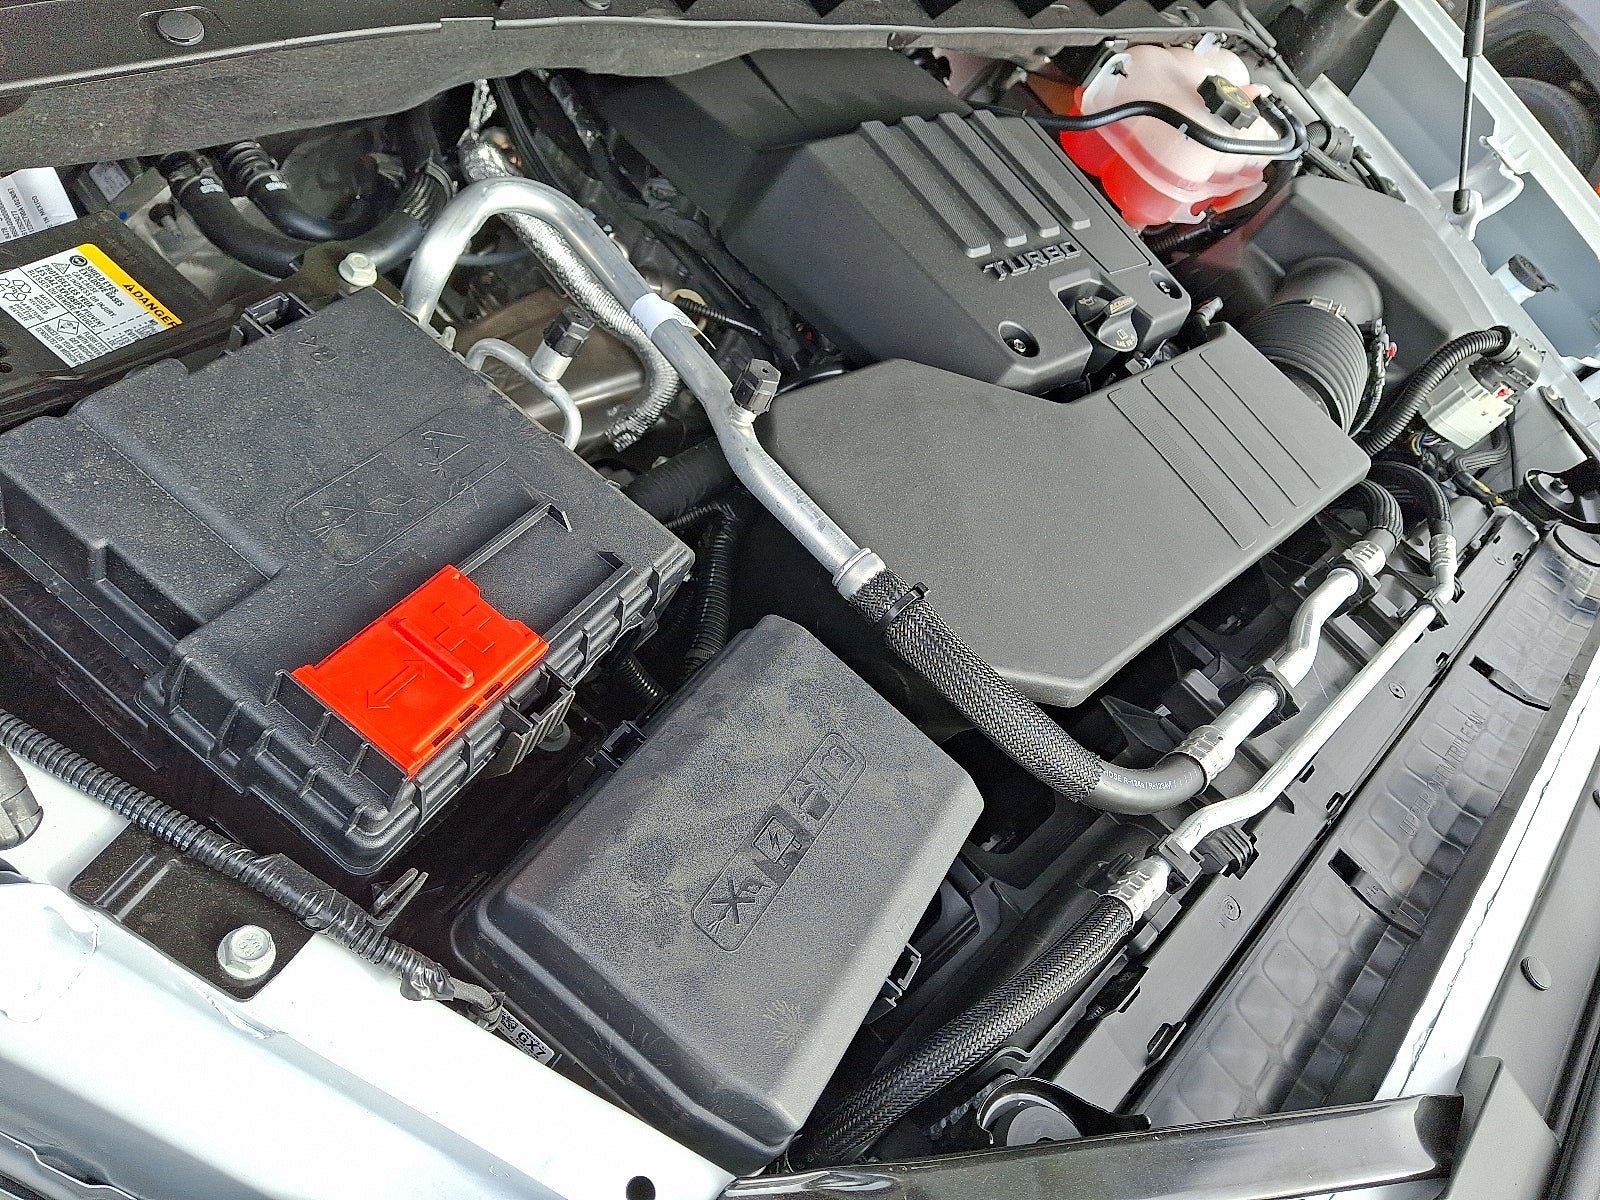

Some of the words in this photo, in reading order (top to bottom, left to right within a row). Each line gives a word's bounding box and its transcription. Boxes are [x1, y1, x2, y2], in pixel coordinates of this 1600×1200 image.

[31, 195, 47, 217] MEXICO
[87, 265, 105, 282] SHIELD
[982, 241, 1082, 281] TURBO
[27, 270, 51, 288] BLESSER
[55, 294, 77, 311] RENDRE
[42, 264, 72, 287] PROTÉGEZ
[68, 286, 80, 296] LES
[65, 273, 93, 297] BLINDNESS
[72, 271, 83, 280] CAN
[83, 279, 99, 293] CAUSE
[79, 268, 109, 293] EXPLOSIVE
[105, 292, 125, 307] GASES
[34, 266, 47, 277] LES
[44, 276, 58, 287] GAZ
[55, 285, 86, 309] EXPLOSIFS
[83, 308, 106, 328] PEUVENT
[517, 1031, 547, 1057] GX7
